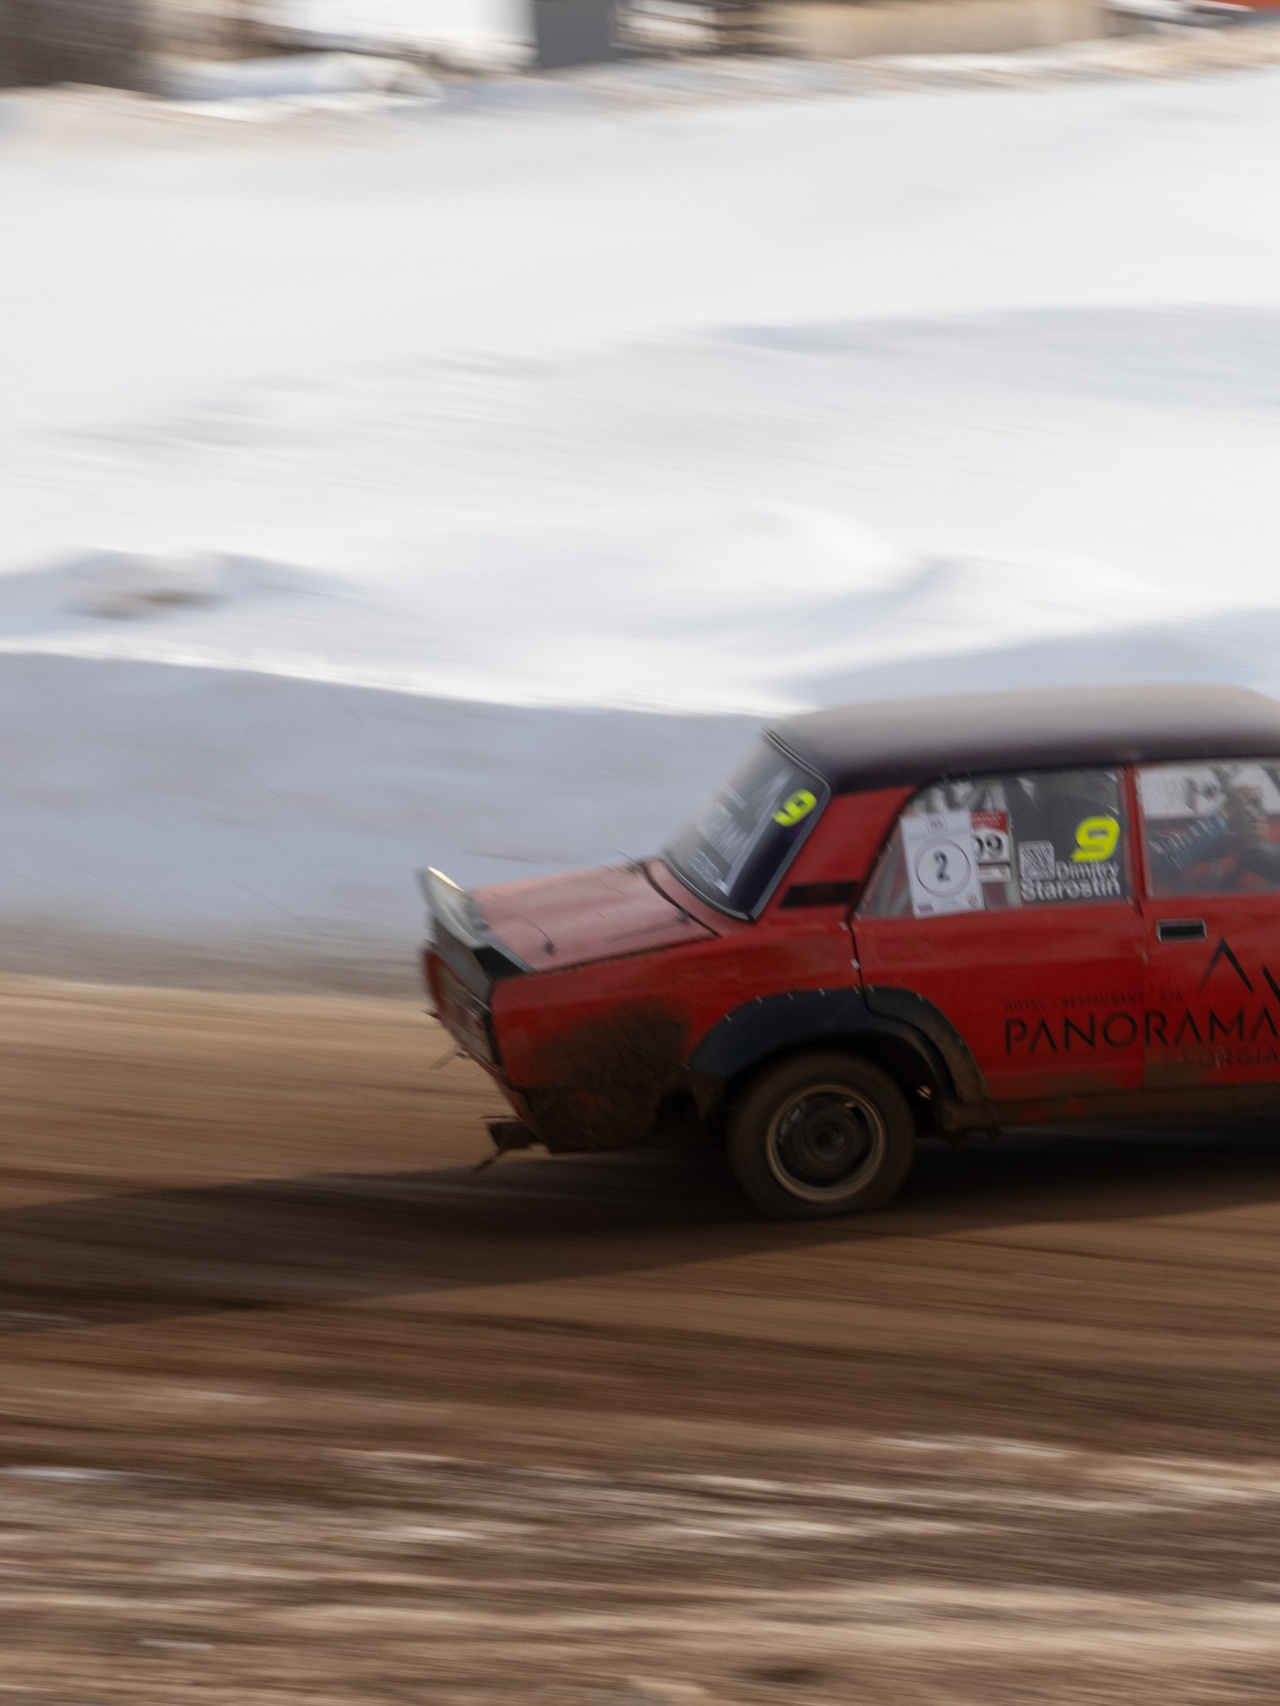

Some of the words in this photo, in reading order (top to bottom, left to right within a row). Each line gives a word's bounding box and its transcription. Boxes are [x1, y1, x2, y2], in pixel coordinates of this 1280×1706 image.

[770, 788, 818, 827] 9
[1069, 815, 1120, 864] 9
[932, 849, 951, 883] 2
[1020, 879, 1121, 901] Starostin
[1004, 1005, 1279, 1055] PANORAMA
